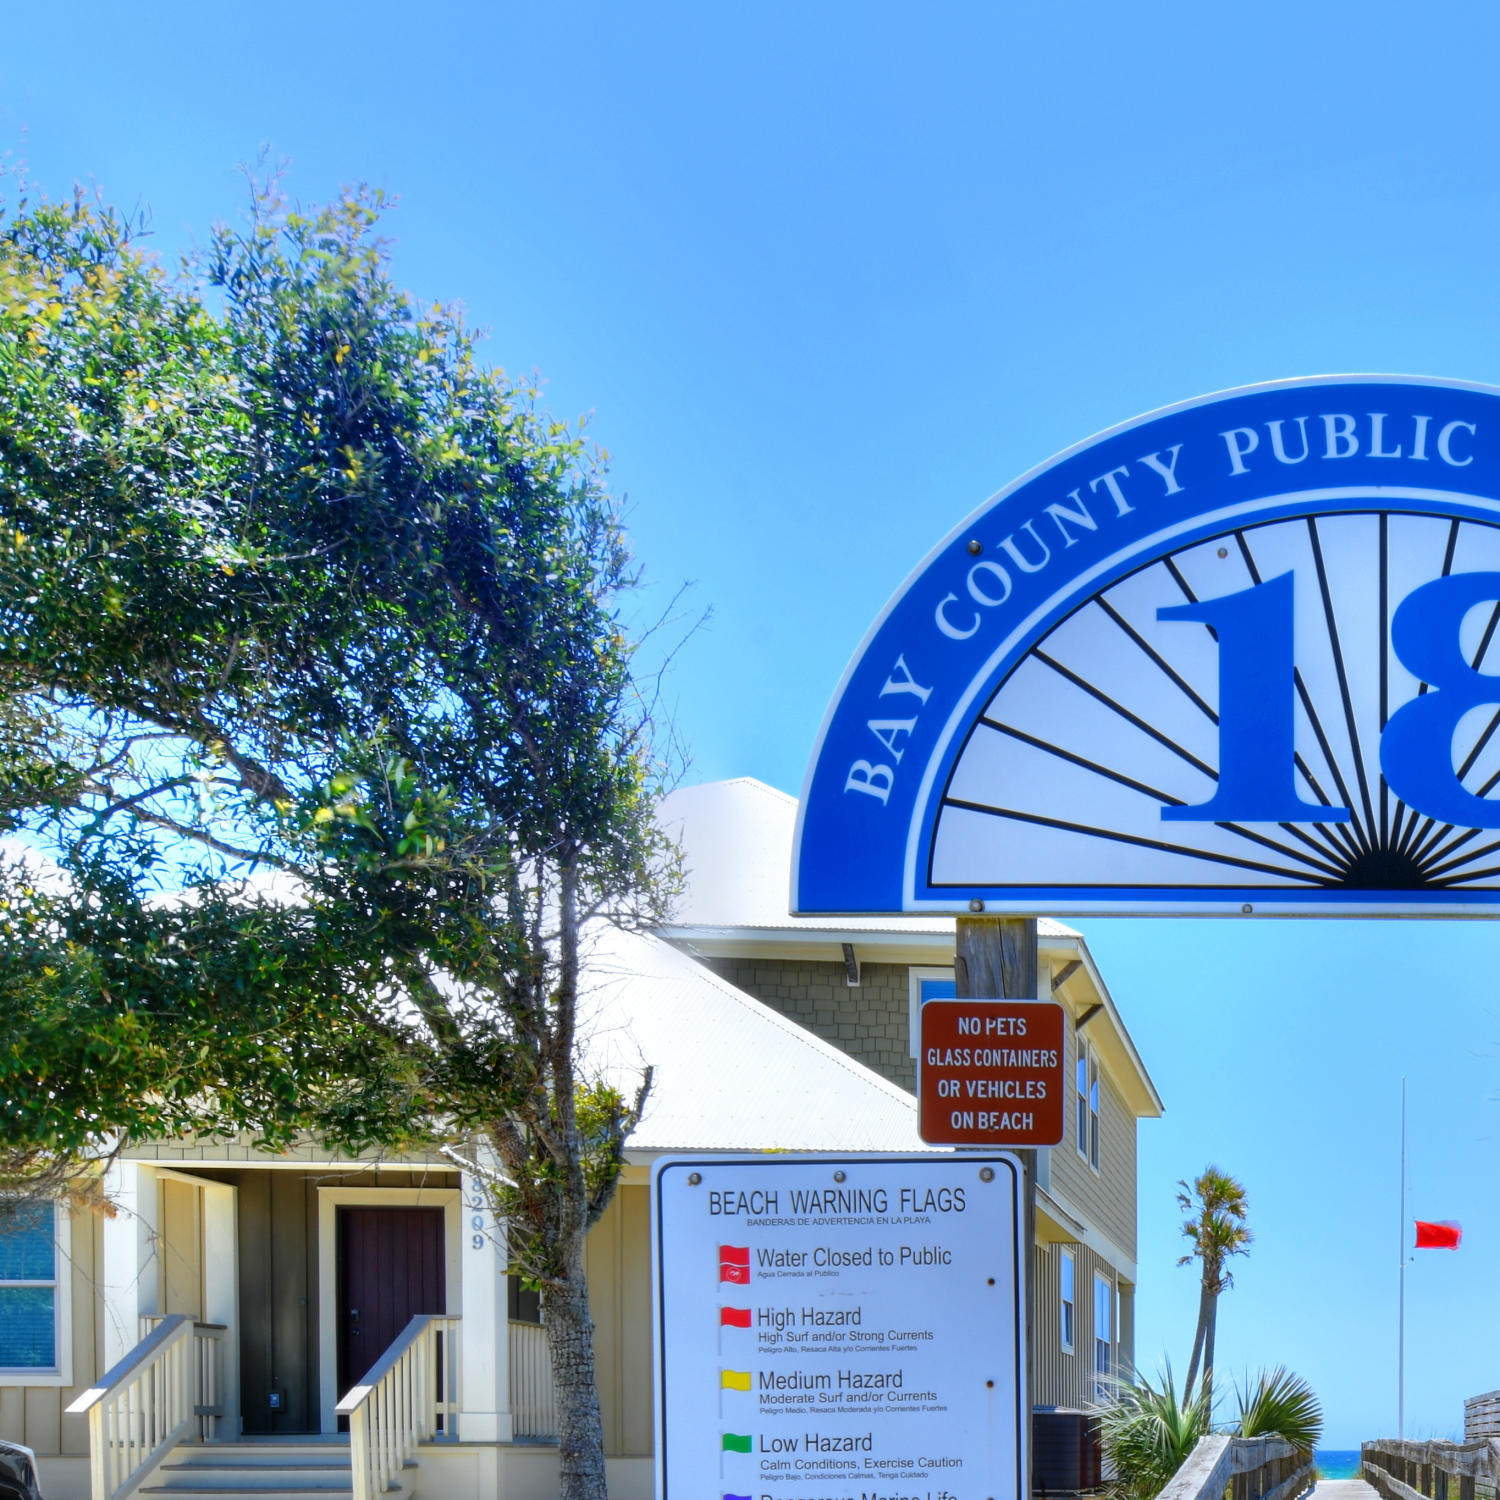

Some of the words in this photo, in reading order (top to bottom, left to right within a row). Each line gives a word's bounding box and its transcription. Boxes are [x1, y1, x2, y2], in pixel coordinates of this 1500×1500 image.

[844, 653, 934, 806] BAY
[935, 443, 1185, 640] COUNTY
[1219, 412, 1477, 476] PUBLIC
[958, 1017, 981, 1035] NO
[986, 1017, 1027, 1036] PETS
[927, 1048, 971, 1066] GLASS
[974, 1049, 1058, 1068] CONTAINERS
[938, 1079, 961, 1098] OR
[966, 1080, 1047, 1099] VEHICLES
[951, 1110, 974, 1130] ON
[978, 1111, 1034, 1130] BEACH
[709, 1191, 778, 1216] BEACH
[790, 1189, 887, 1214] WARNING
[900, 1188, 967, 1212] FLAGS
[746, 1217, 795, 1227] BANDERAS
[797, 1217, 809, 1226] DE
[812, 1217, 874, 1226] ADVERTENCIA
[876, 1216, 888, 1226] EN
[890, 1216, 902, 1225] LA
[903, 1216, 930, 1225] PLAYA
[756, 1247, 808, 1268] Water
[813, 1247, 872, 1267] Closed
[878, 1247, 894, 1267] to
[899, 1246, 952, 1267] Public
[758, 1307, 795, 1331] High
[801, 1306, 862, 1325] Hazard
[759, 1332, 782, 1345] High
[786, 1331, 808, 1344] Surf
[812, 1331, 846, 1344] and/or
[850, 1330, 883, 1343] Strong
[888, 1329, 934, 1341] Currents
[759, 1370, 830, 1390] Medium
[838, 1369, 902, 1389] Hazard
[759, 1392, 814, 1405] Moderate
[818, 1392, 842, 1404] Surf
[846, 1391, 883, 1404] and/or
[887, 1390, 937, 1403] Currents
[761, 1433, 799, 1453] Low
[806, 1432, 872, 1451] Hazard
[760, 1459, 790, 1472] Calm
[795, 1458, 859, 1472] Conditions,
[864, 1457, 913, 1471] Exercise
[918, 1456, 962, 1470] Caution
